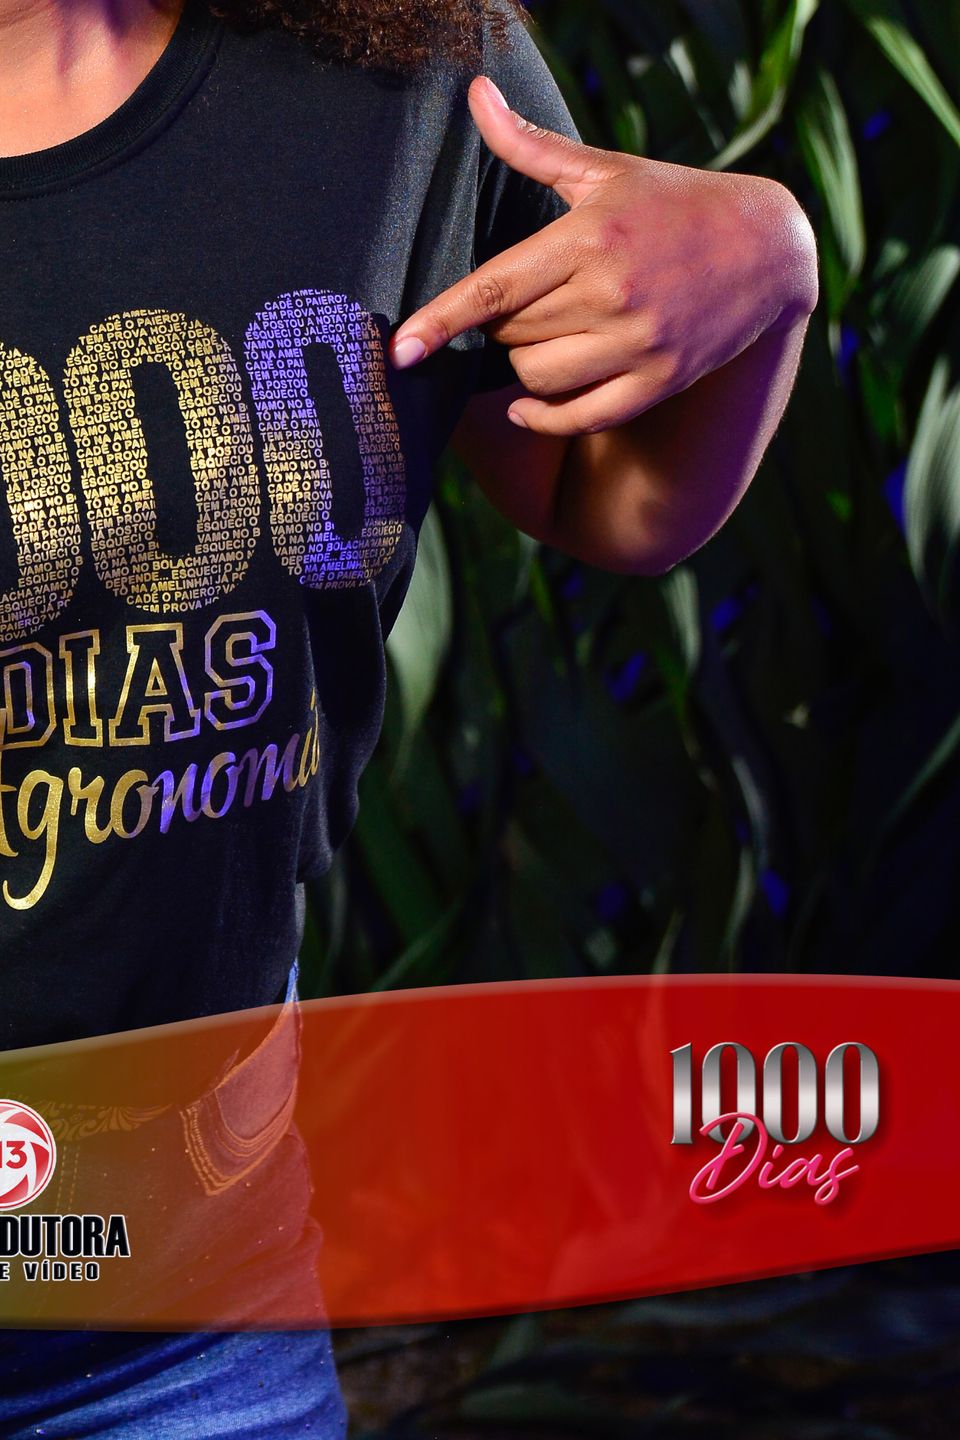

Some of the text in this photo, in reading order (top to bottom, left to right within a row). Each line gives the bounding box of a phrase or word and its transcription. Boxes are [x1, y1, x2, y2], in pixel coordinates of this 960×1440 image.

[264, 297, 293, 310] CADÊ
[295, 298, 303, 308] O
[255, 303, 349, 320] TEM PROVA HOJE?
[89, 319, 122, 334] CADÊ
[125, 319, 134, 329] O
[262, 318, 304, 330] POSTOU
[307, 317, 314, 326] A
[315, 313, 347, 325] NOTA?
[78, 321, 187, 345] TEM PROVA HOJE?
[245, 323, 345, 340] ESQUECI O JALECO!
[66, 333, 218, 367] ESQUECI O JALECO! CADÊ
[85, 339, 134, 354] POSTOU
[137, 337, 146, 347] A
[148, 331, 185, 345] NOTA?
[243, 338, 292, 351] VAMO NO
[63, 346, 213, 377] VAMO NO TEM
[165, 358, 182, 371] TÔ
[185, 357, 202, 368] NA
[3, 362, 36, 379] CADÊ
[5, 375, 31, 388] TEM
[1, 388, 19, 400] NA
[23, 396, 33, 406] O
[97, 566, 129, 580] VAMO
[132, 562, 149, 573] NO
[171, 564, 221, 580] ESQUECI
[224, 562, 232, 574] O
[131, 583, 148, 593] NA
[48, 593, 57, 606] O
[126, 590, 159, 605] CADÊ
[162, 592, 171, 602] O
[162, 600, 202, 613] PROVA
